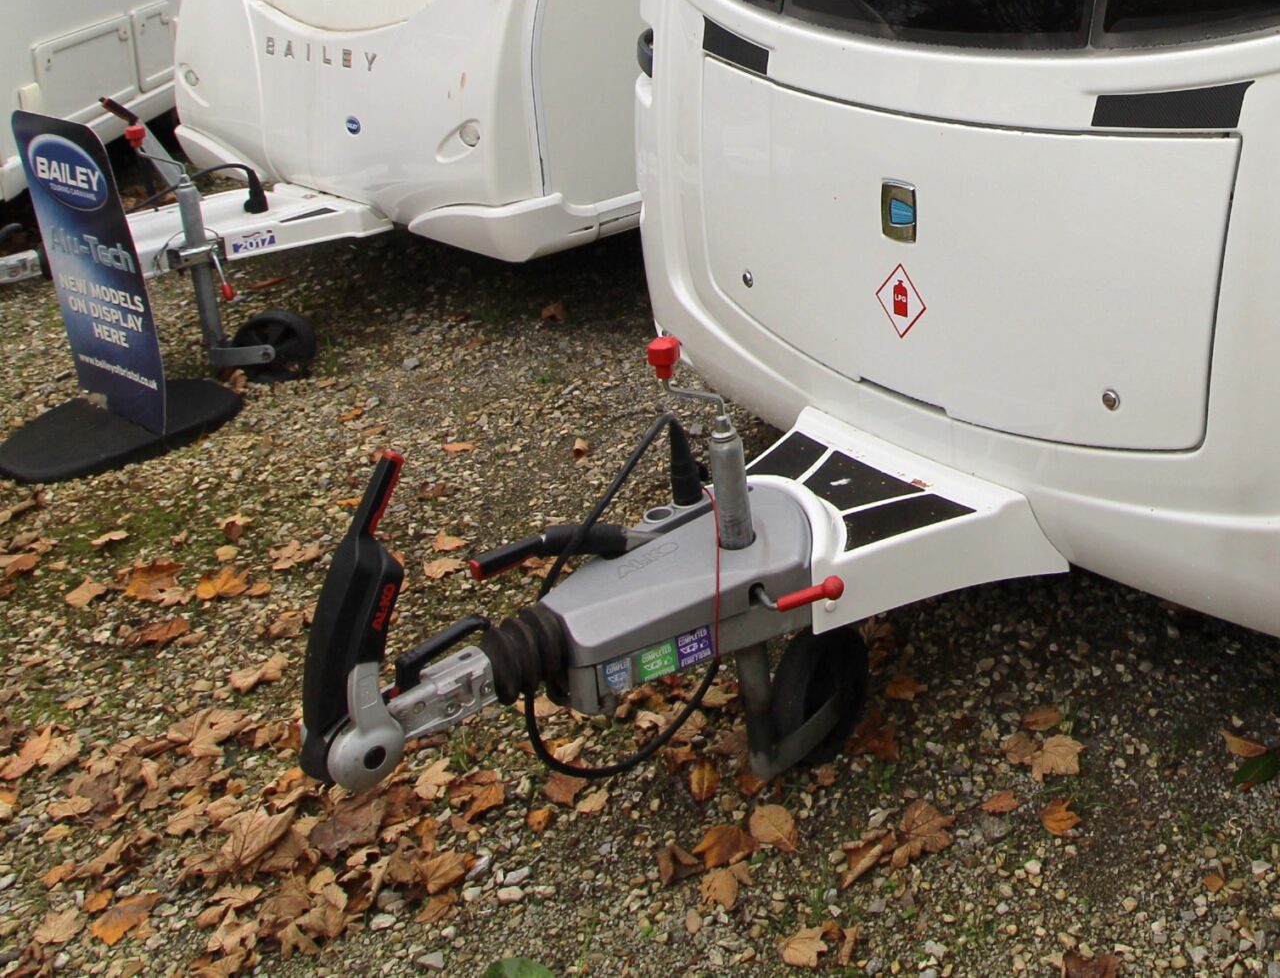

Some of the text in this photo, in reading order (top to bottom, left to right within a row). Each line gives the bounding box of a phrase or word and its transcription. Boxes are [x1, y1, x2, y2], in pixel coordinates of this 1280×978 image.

[265, 36, 377, 72] BAILEY
[36, 156, 99, 192] BAILEY
[50, 225, 135, 273] Alu-Tech
[238, 235, 271, 253] 2017
[59, 274, 144, 313] NEW MODELS
[895, 294, 906, 303] LPG
[68, 295, 143, 333] ON DISPLAY
[93, 322, 129, 349] HERE
